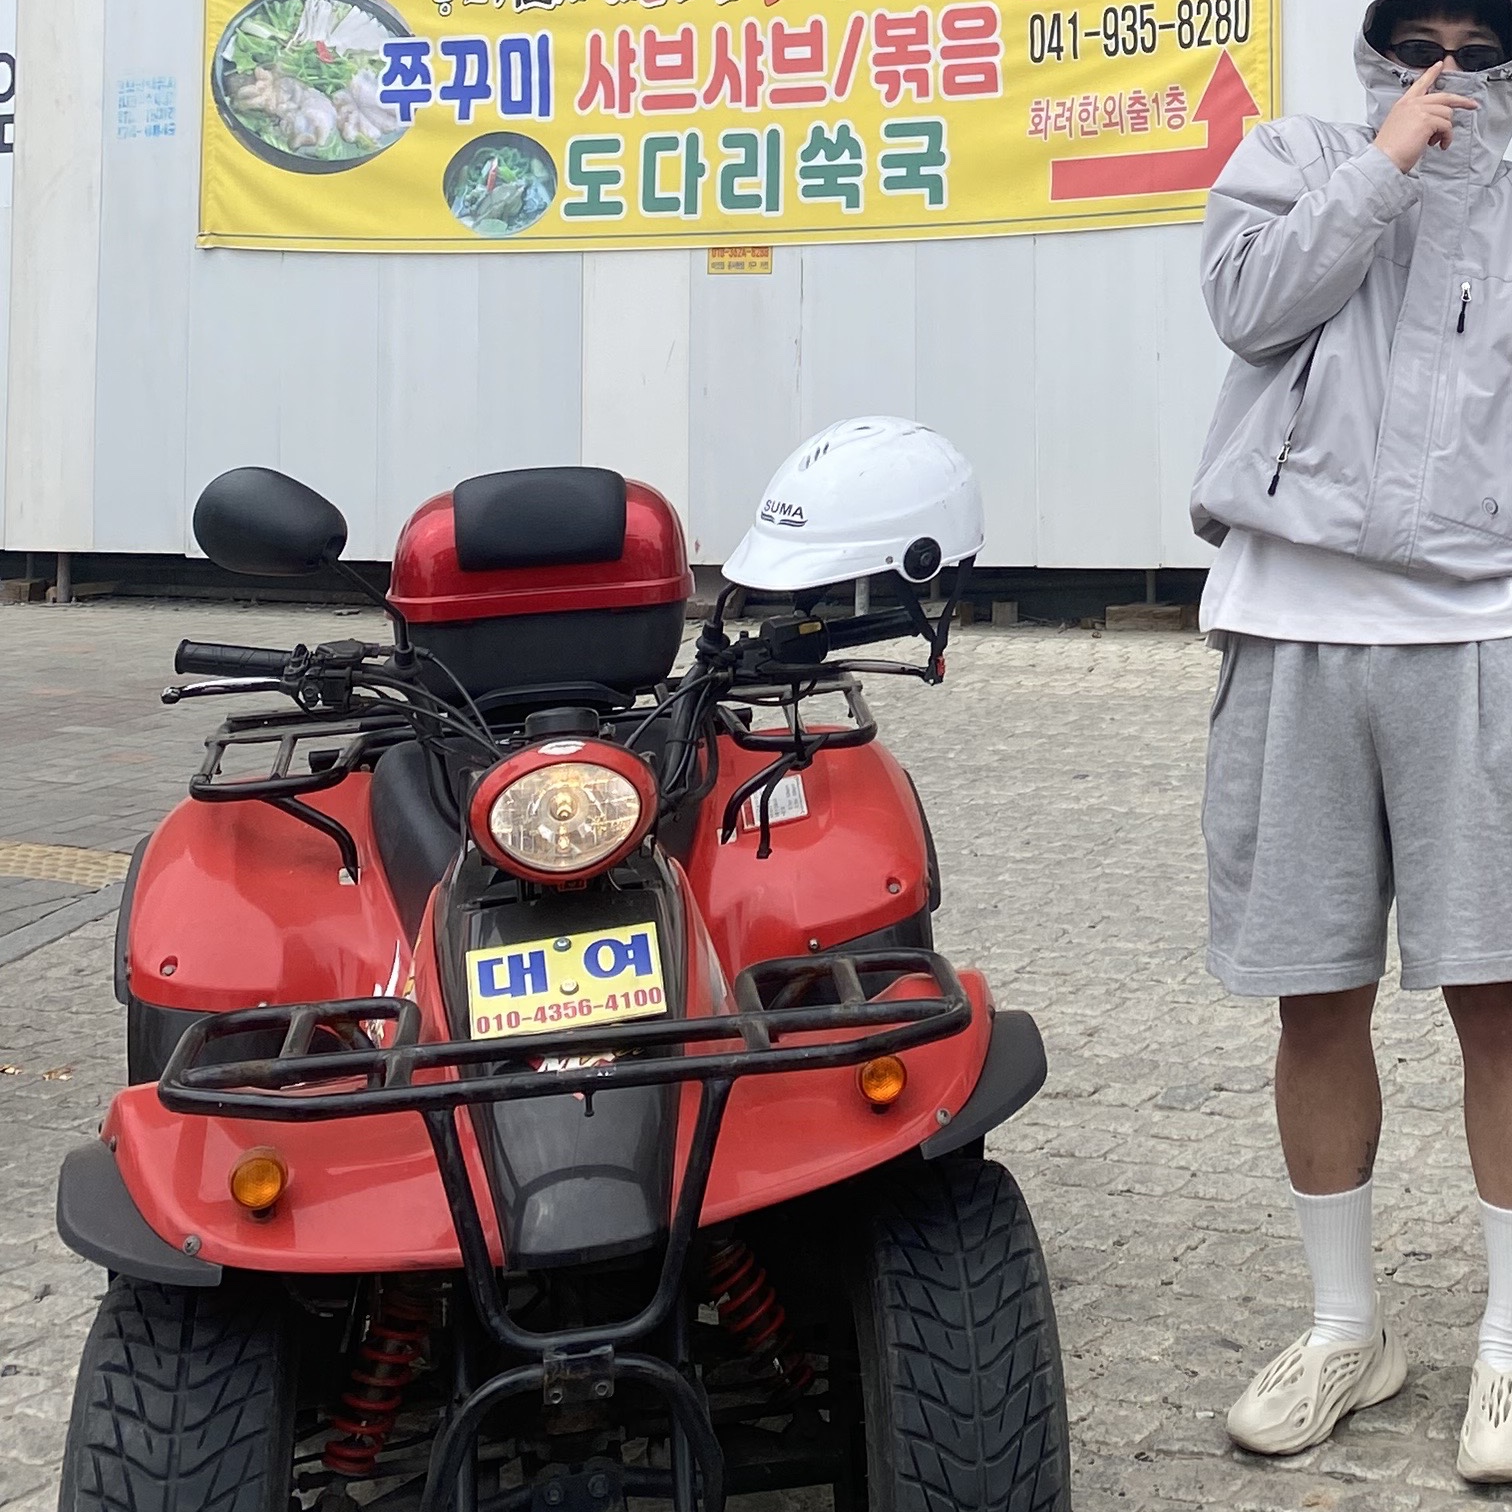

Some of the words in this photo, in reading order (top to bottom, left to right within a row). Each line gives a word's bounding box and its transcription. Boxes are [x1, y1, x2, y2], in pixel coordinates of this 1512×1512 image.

[379, 33, 555, 125] 쭈꾸미
[576, 0, 1003, 116] 샤브샤브/볶음
[763, 498, 804, 520] SUMA
[476, 986, 663, 1035] 010-4356-4100
